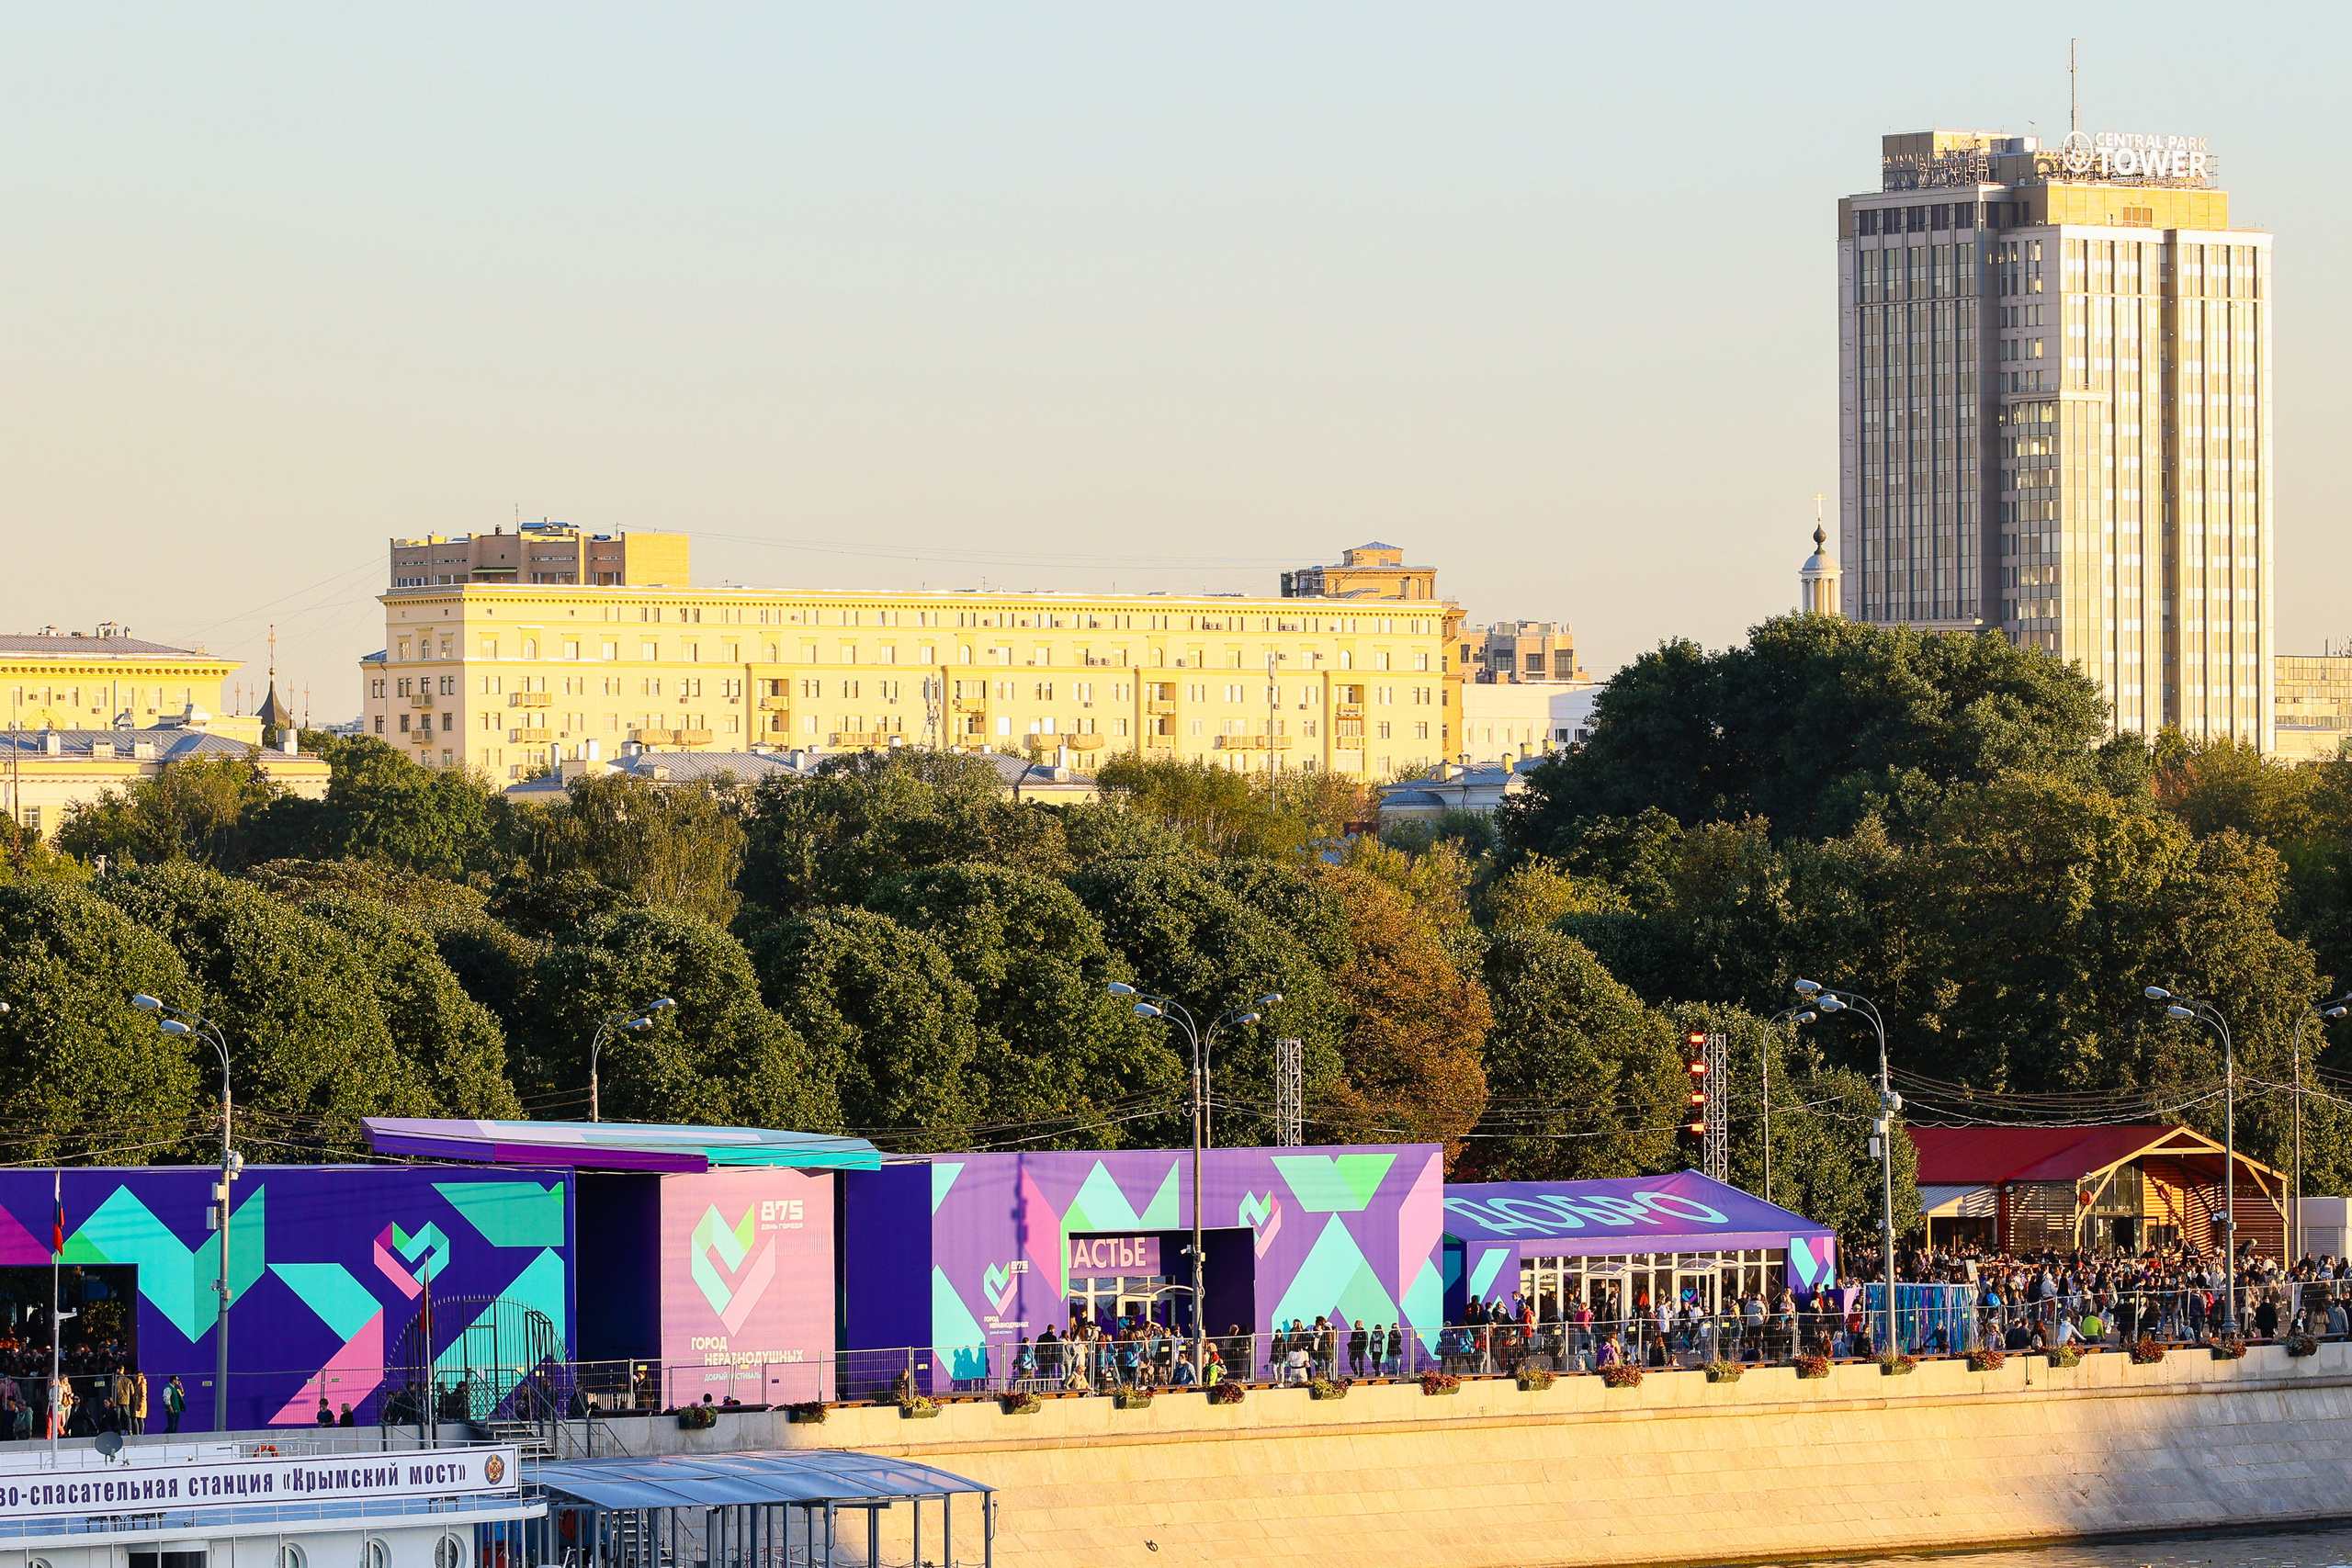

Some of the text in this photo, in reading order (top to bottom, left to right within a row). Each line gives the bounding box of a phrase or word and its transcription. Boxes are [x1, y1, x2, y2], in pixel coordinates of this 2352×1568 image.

[2095, 131, 2208, 151] CENTRAL PARK
[2095, 146, 2209, 178] TOWER
[761, 1200, 804, 1221] 875
[1443, 1191, 1729, 1235] ДОБРО
[1069, 1236, 1147, 1269] АСТЬЕ
[691, 1336, 729, 1351] ГОРОД
[704, 1349, 804, 1366] НЕРАВНОДУШНЫХ
[188, 1473, 273, 1496] станция
[283, 1461, 399, 1493] «Крымский
[409, 1463, 466, 1484] мост»
